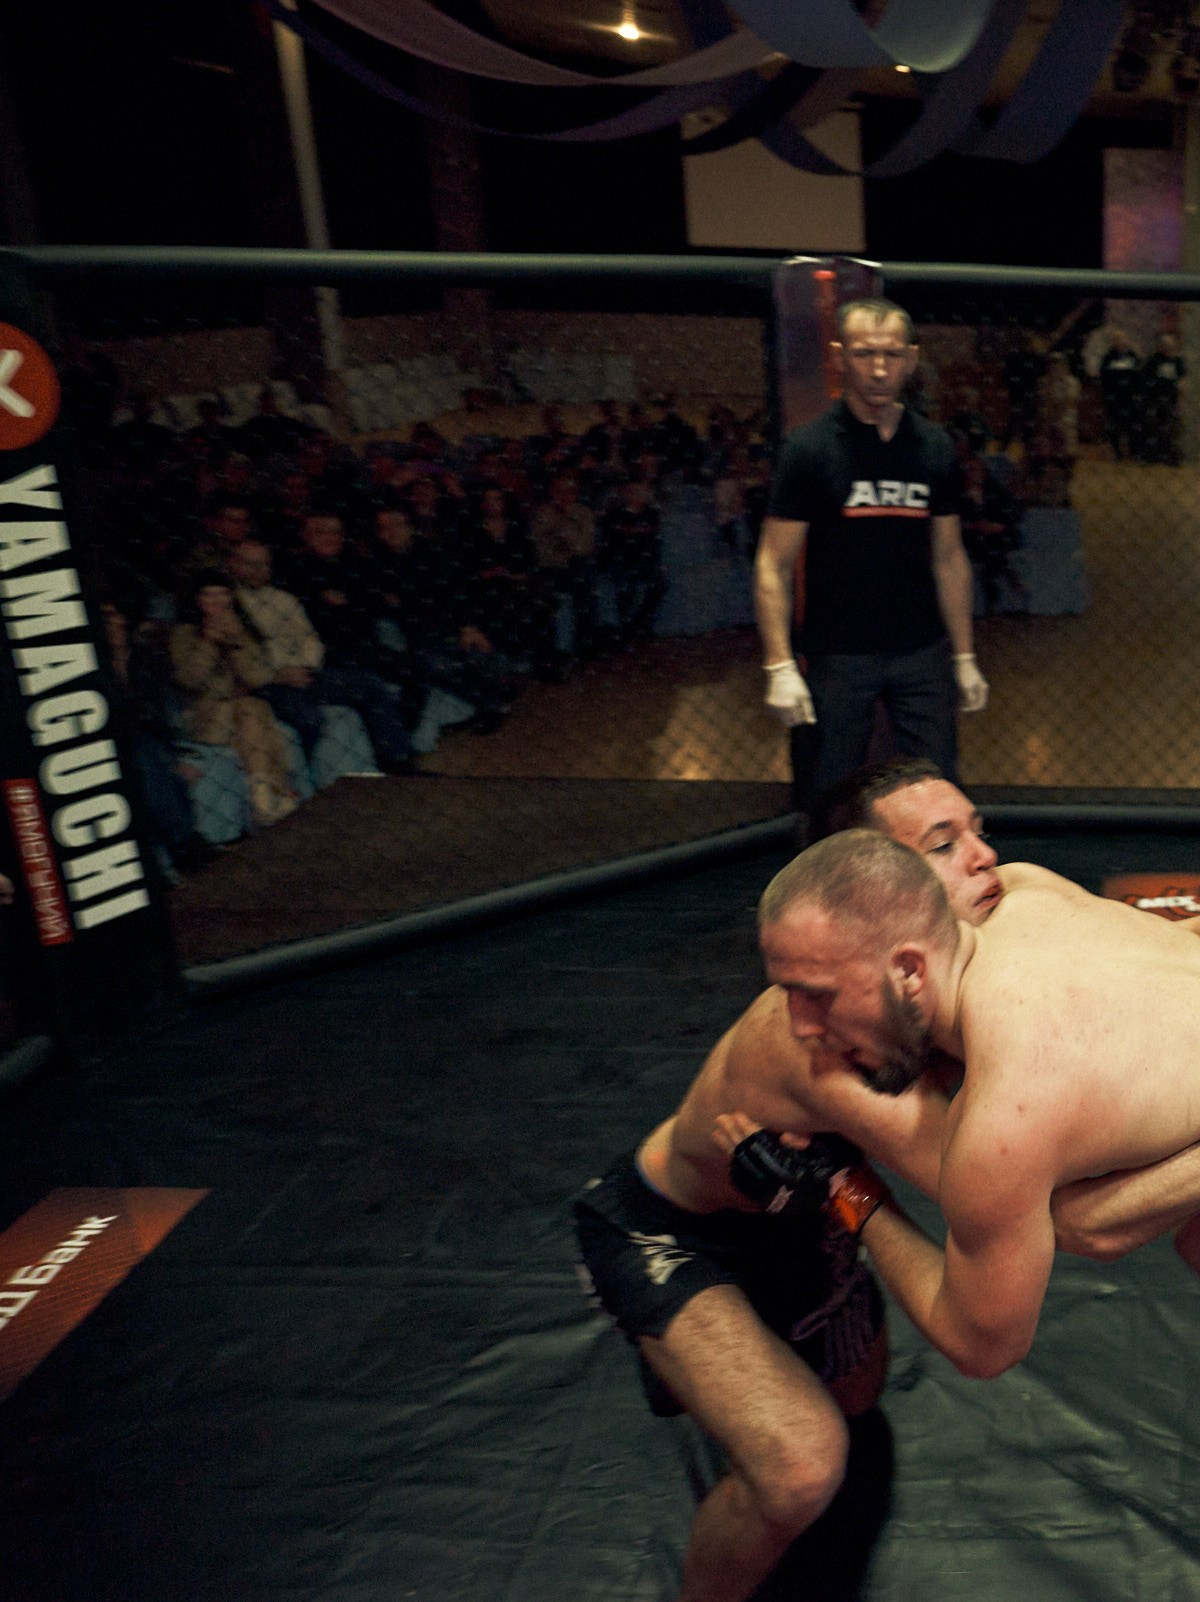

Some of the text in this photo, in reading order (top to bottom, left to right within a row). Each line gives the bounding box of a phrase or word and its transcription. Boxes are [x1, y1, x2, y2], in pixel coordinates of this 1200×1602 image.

[844, 479, 931, 509] ARC
[0, 464, 151, 930] YAMAGUCHI
[7, 1215, 120, 1285] Банк
